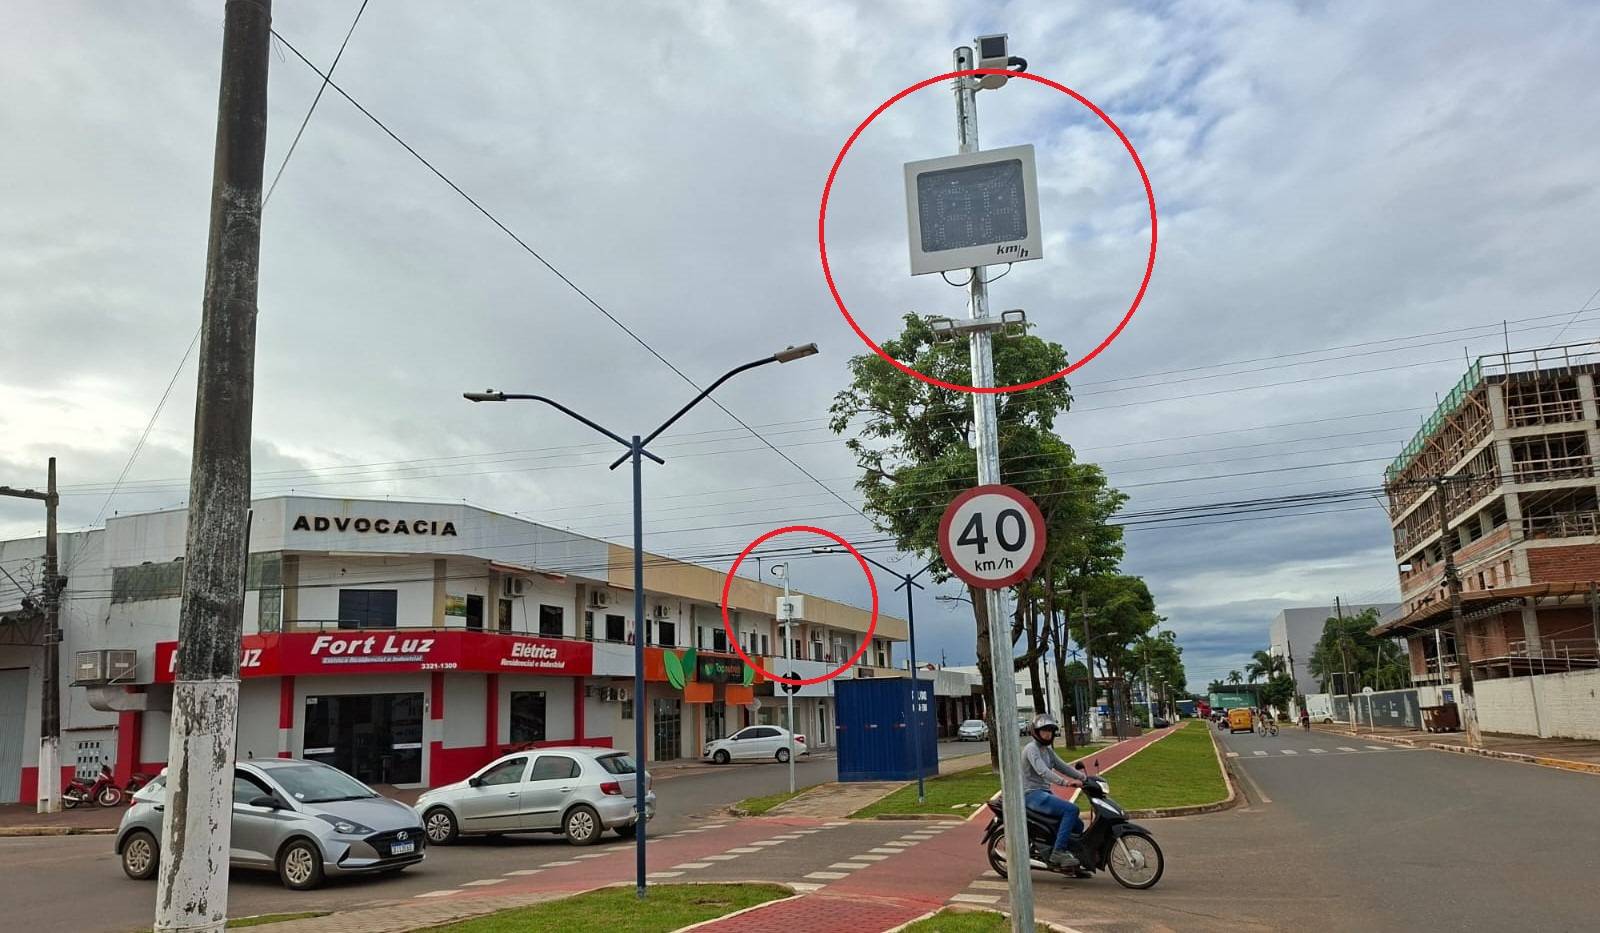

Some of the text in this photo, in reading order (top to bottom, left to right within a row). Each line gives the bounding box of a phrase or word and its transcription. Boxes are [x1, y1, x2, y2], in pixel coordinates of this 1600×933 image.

[997, 244, 1029, 258] km/h
[293, 515, 458, 537] ADVOCACIA
[957, 508, 1027, 555] 40
[974, 557, 1014, 571] km/h
[310, 635, 435, 655] Fort Luz
[511, 642, 558, 660] Elétrica
[421, 662, 457, 670] 3321-1300
